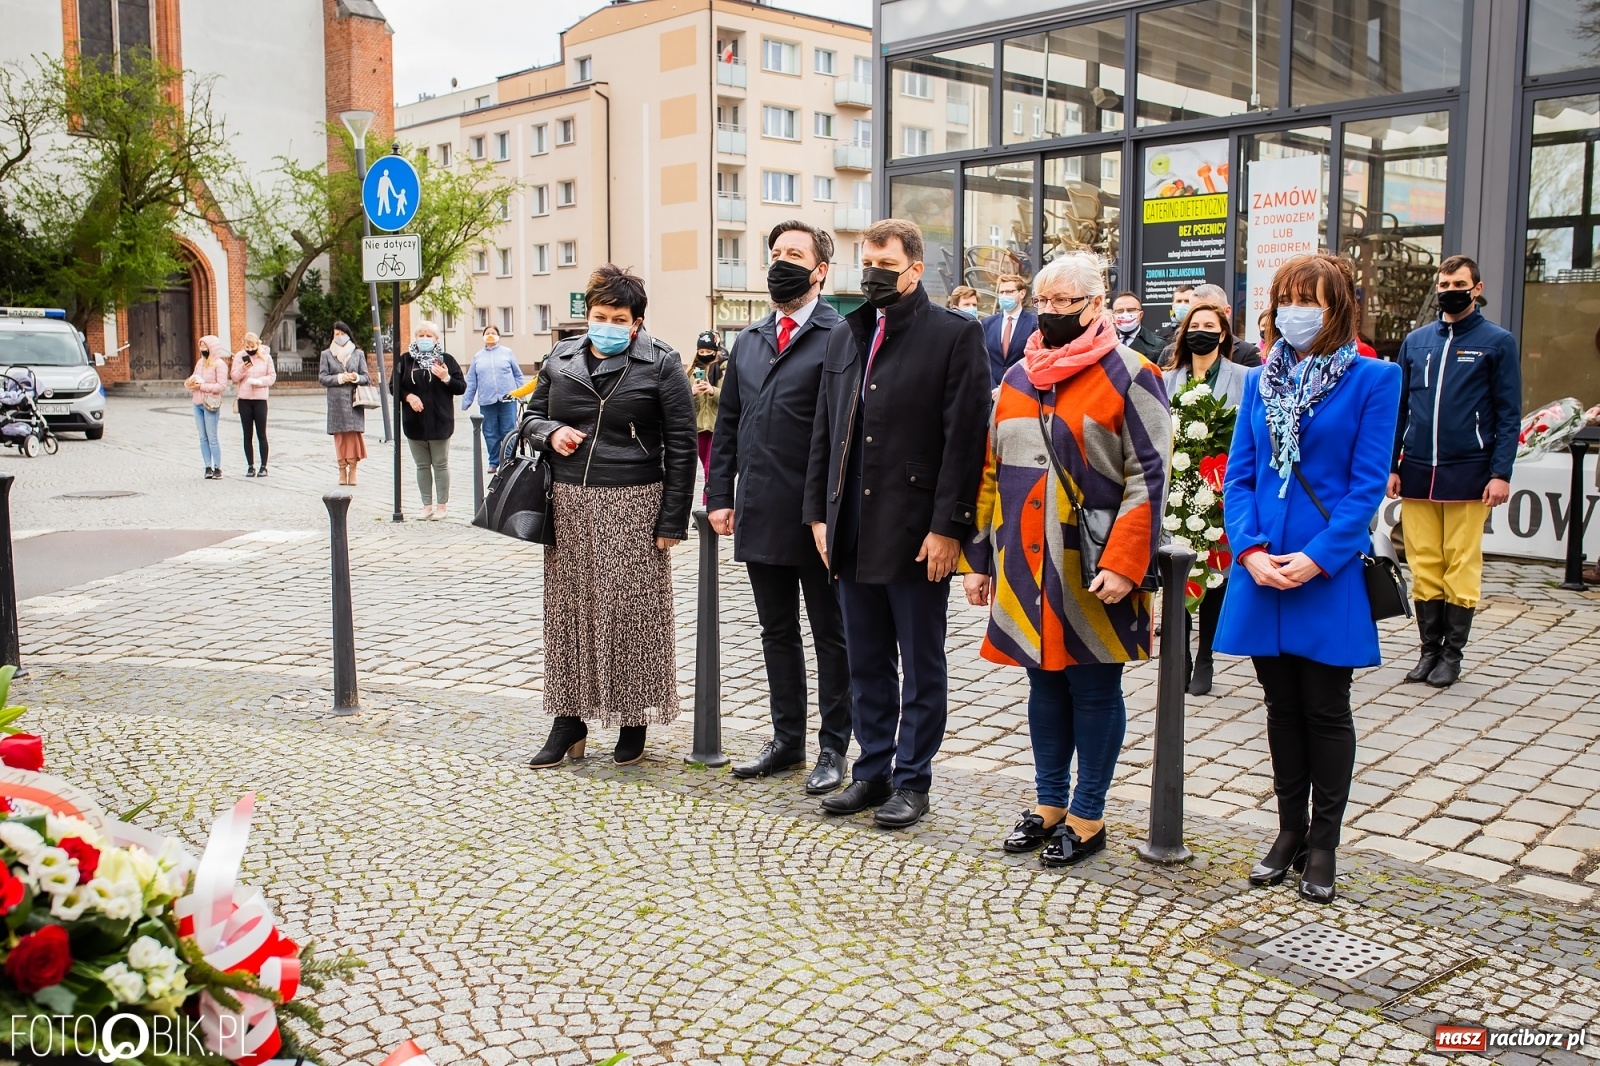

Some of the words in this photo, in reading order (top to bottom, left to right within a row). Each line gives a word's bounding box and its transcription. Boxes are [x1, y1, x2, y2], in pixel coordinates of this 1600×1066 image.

[1252, 186, 1318, 209] ZAMÓW
[1145, 201, 1178, 220] CATERING
[1180, 197, 1227, 218] DIETETYCZNY
[1254, 215, 1261, 225] Z
[1263, 212, 1315, 225] DOWOZEM
[1178, 225, 1192, 237] BEZ
[1193, 222, 1226, 236] PSZENICY
[1272, 228, 1293, 239] LUB
[365, 240, 380, 249] Nie
[383, 239, 417, 251] dotyczy
[1257, 241, 1311, 254] ODBIOREM
[1257, 259, 1266, 268] W
[1253, 287, 1264, 296] 32
[1254, 301, 1264, 310] 32
